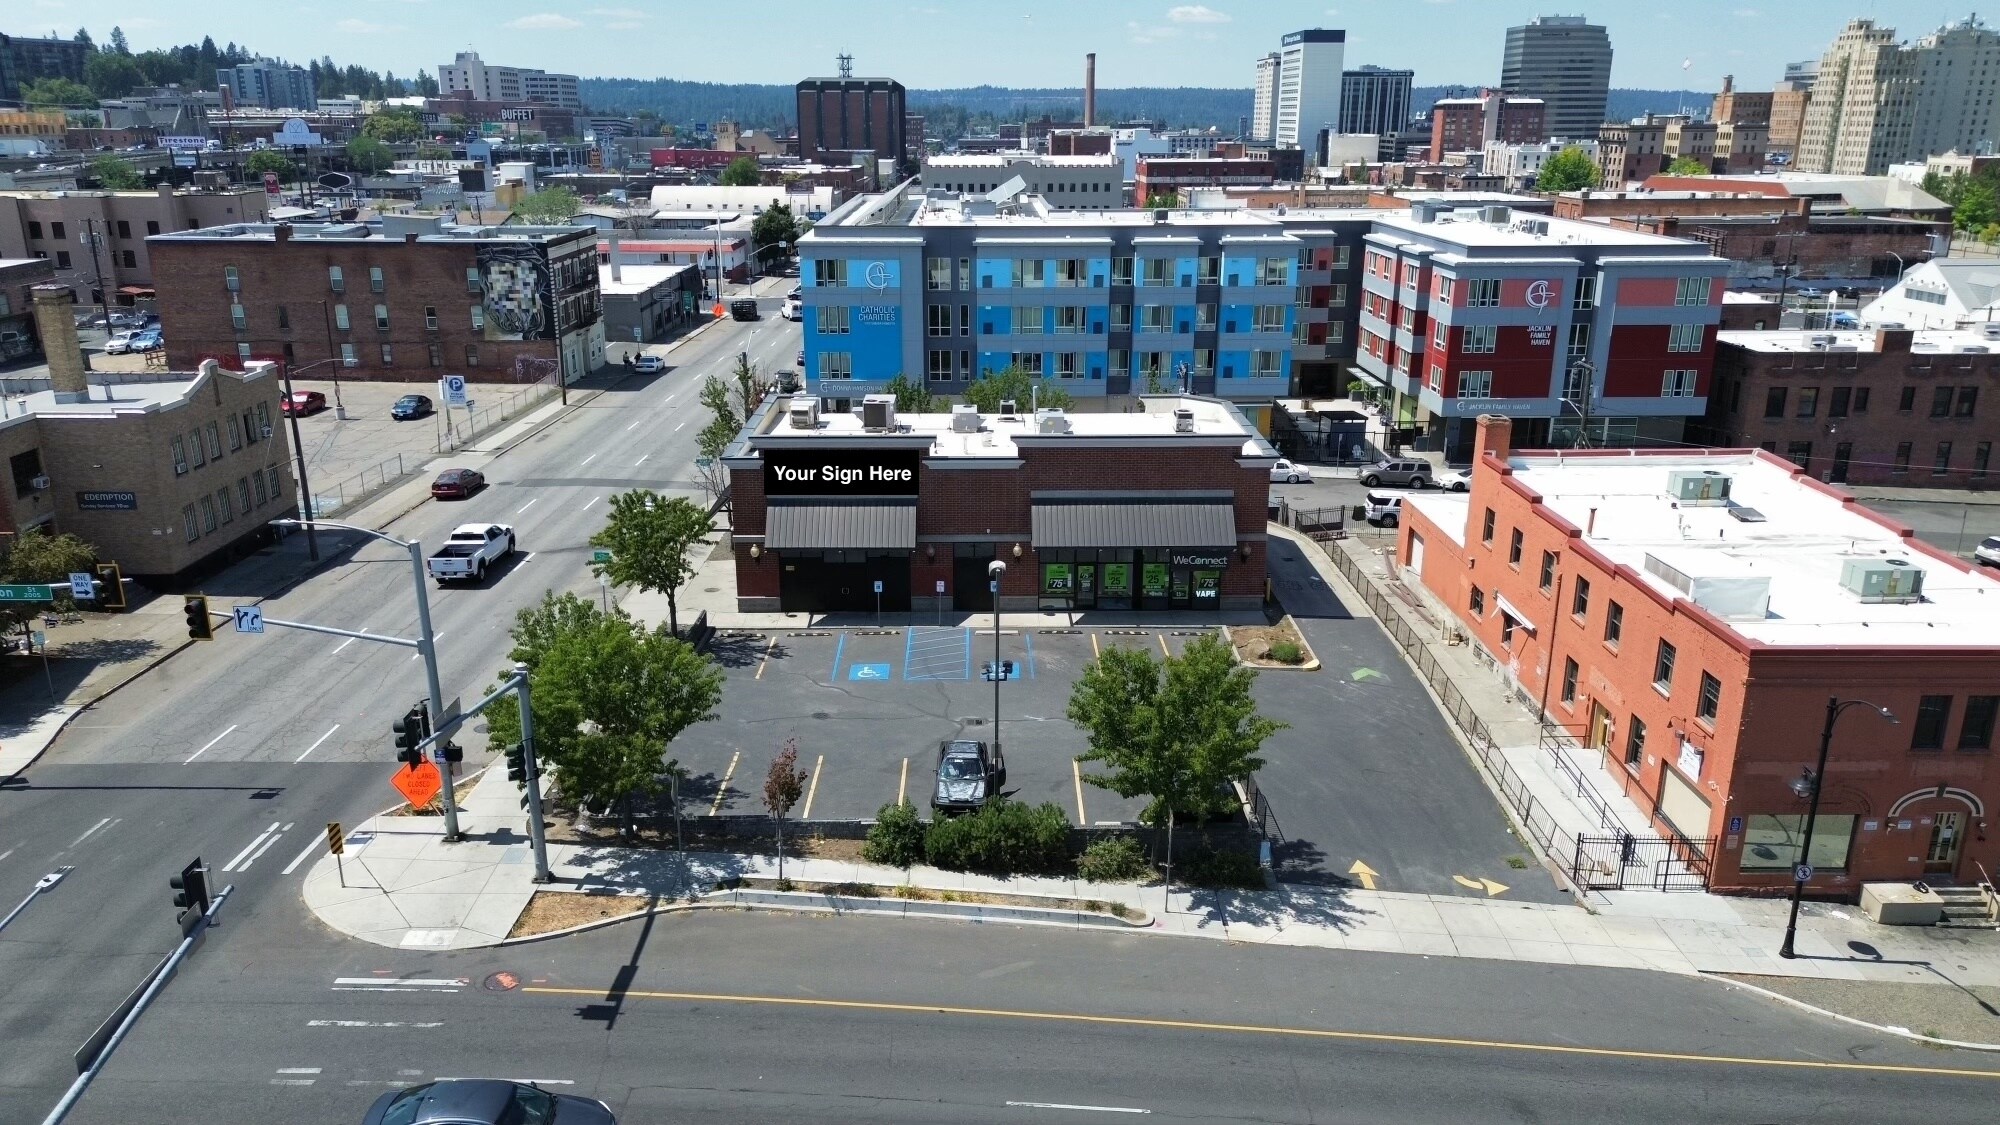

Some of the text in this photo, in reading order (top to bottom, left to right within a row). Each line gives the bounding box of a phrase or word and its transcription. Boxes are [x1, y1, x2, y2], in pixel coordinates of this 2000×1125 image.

[501, 108, 533, 120] BUFFET
[1173, 555, 1228, 565] WeConnect
[1195, 590, 1216, 598] VAPE
[407, 780, 431, 788] CLOSED
[409, 788, 429, 796] AHEAD
